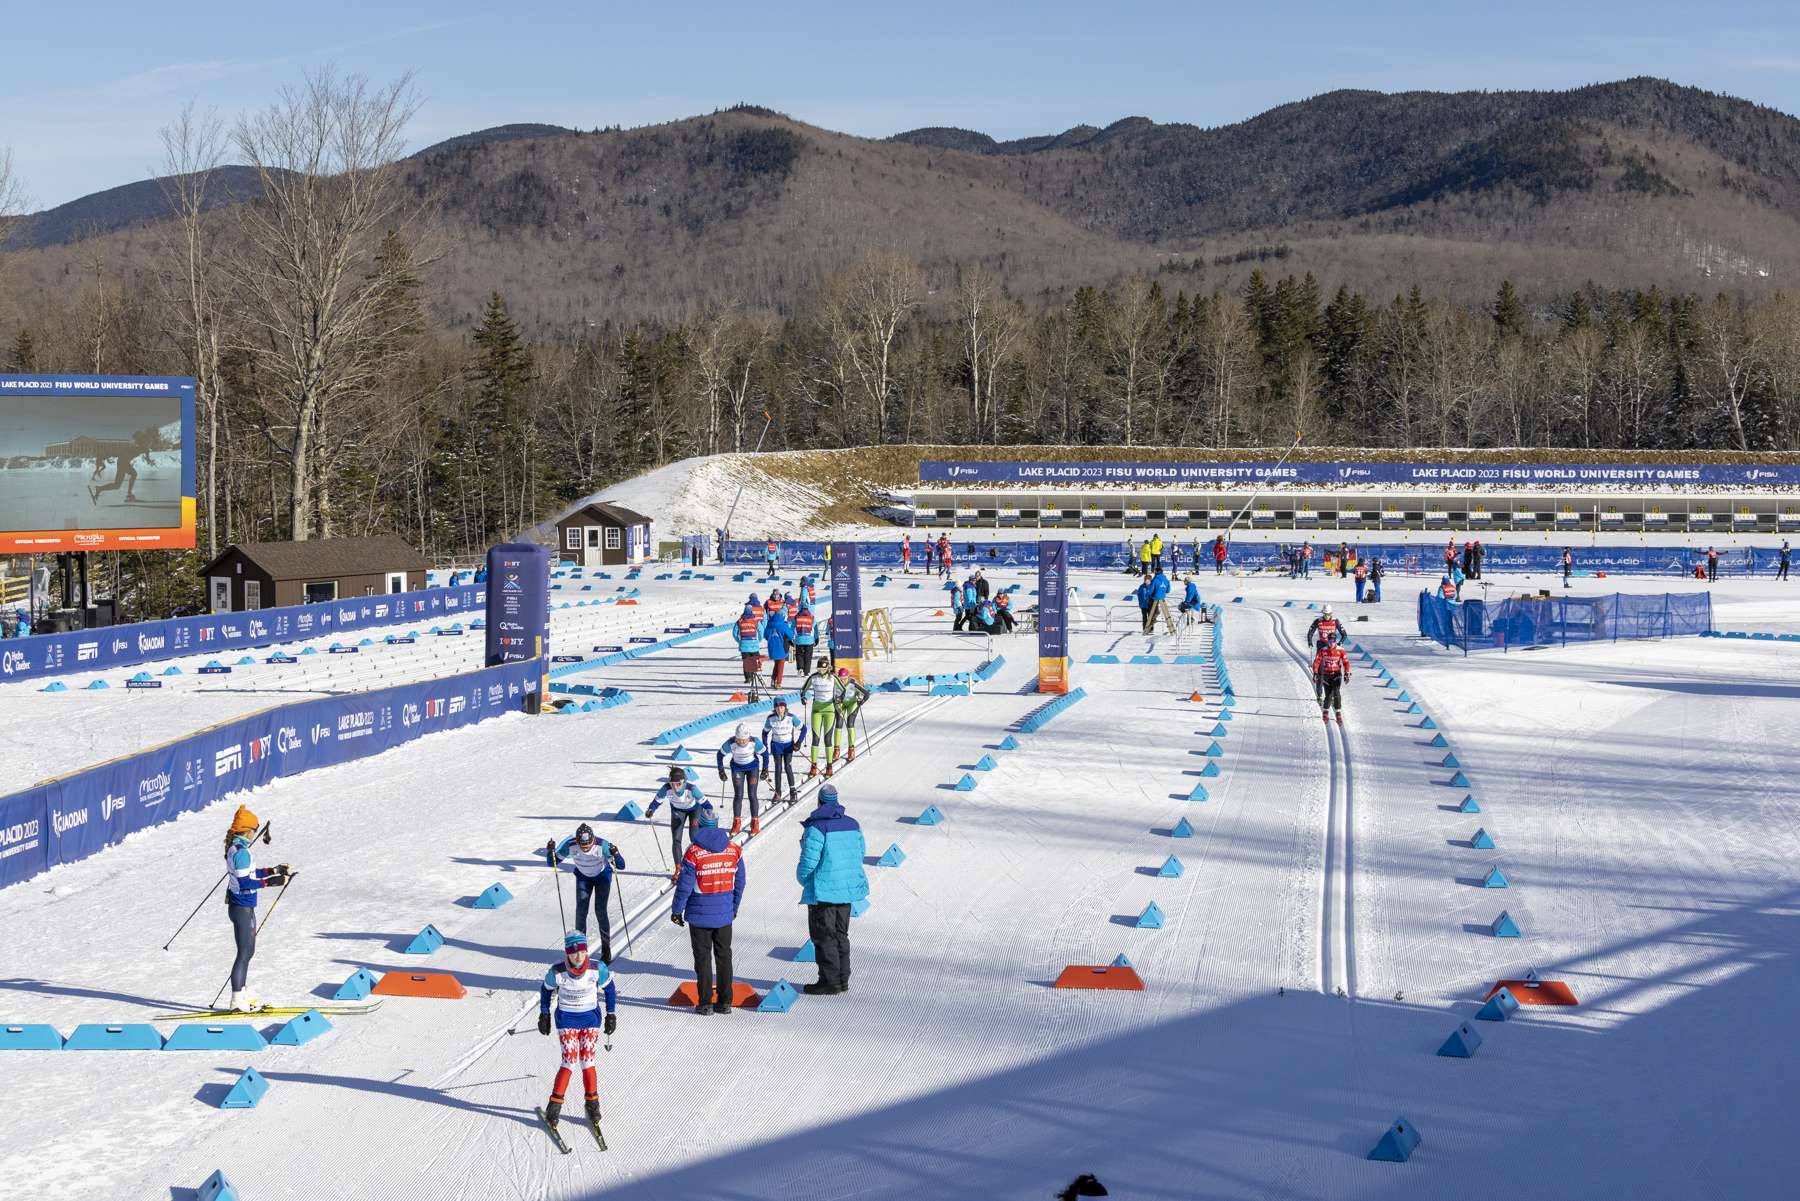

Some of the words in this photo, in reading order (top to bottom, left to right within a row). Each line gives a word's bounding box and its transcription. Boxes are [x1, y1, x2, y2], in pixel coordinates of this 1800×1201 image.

[1, 381, 18, 389] LAKE
[18, 381, 39, 389] PLACID
[101, 382, 143, 390] UNIVERSITY
[1019, 468, 1043, 476] LAKE
[1046, 468, 1081, 476] PLACID
[1081, 468, 1102, 476] 2023
[1106, 468, 1132, 477] FISU
[1135, 468, 1178, 477] WORLD
[1181, 468, 1252, 477] UNIVERSITY
[1255, 468, 1297, 477] GAMES
[1412, 469, 1438, 477] LAKE
[1440, 469, 1475, 477] PLACID
[1478, 469, 1500, 477] 2023
[1503, 469, 1530, 478] FISU
[1533, 469, 1576, 478] WORLD
[1580, 469, 1654, 478] UNIVERSITY
[1657, 469, 1700, 478] GAMES
[1576, 558, 1600, 566] LAKE
[1602, 558, 1640, 566] PLACID
[511, 638, 524, 646] NY
[78, 642, 98, 661] ESPN
[434, 699, 446, 719] NY
[449, 696, 466, 714] ESPN
[260, 734, 272, 760] NY
[215, 744, 242, 777] ESPN
[23, 820, 39, 839] 2023
